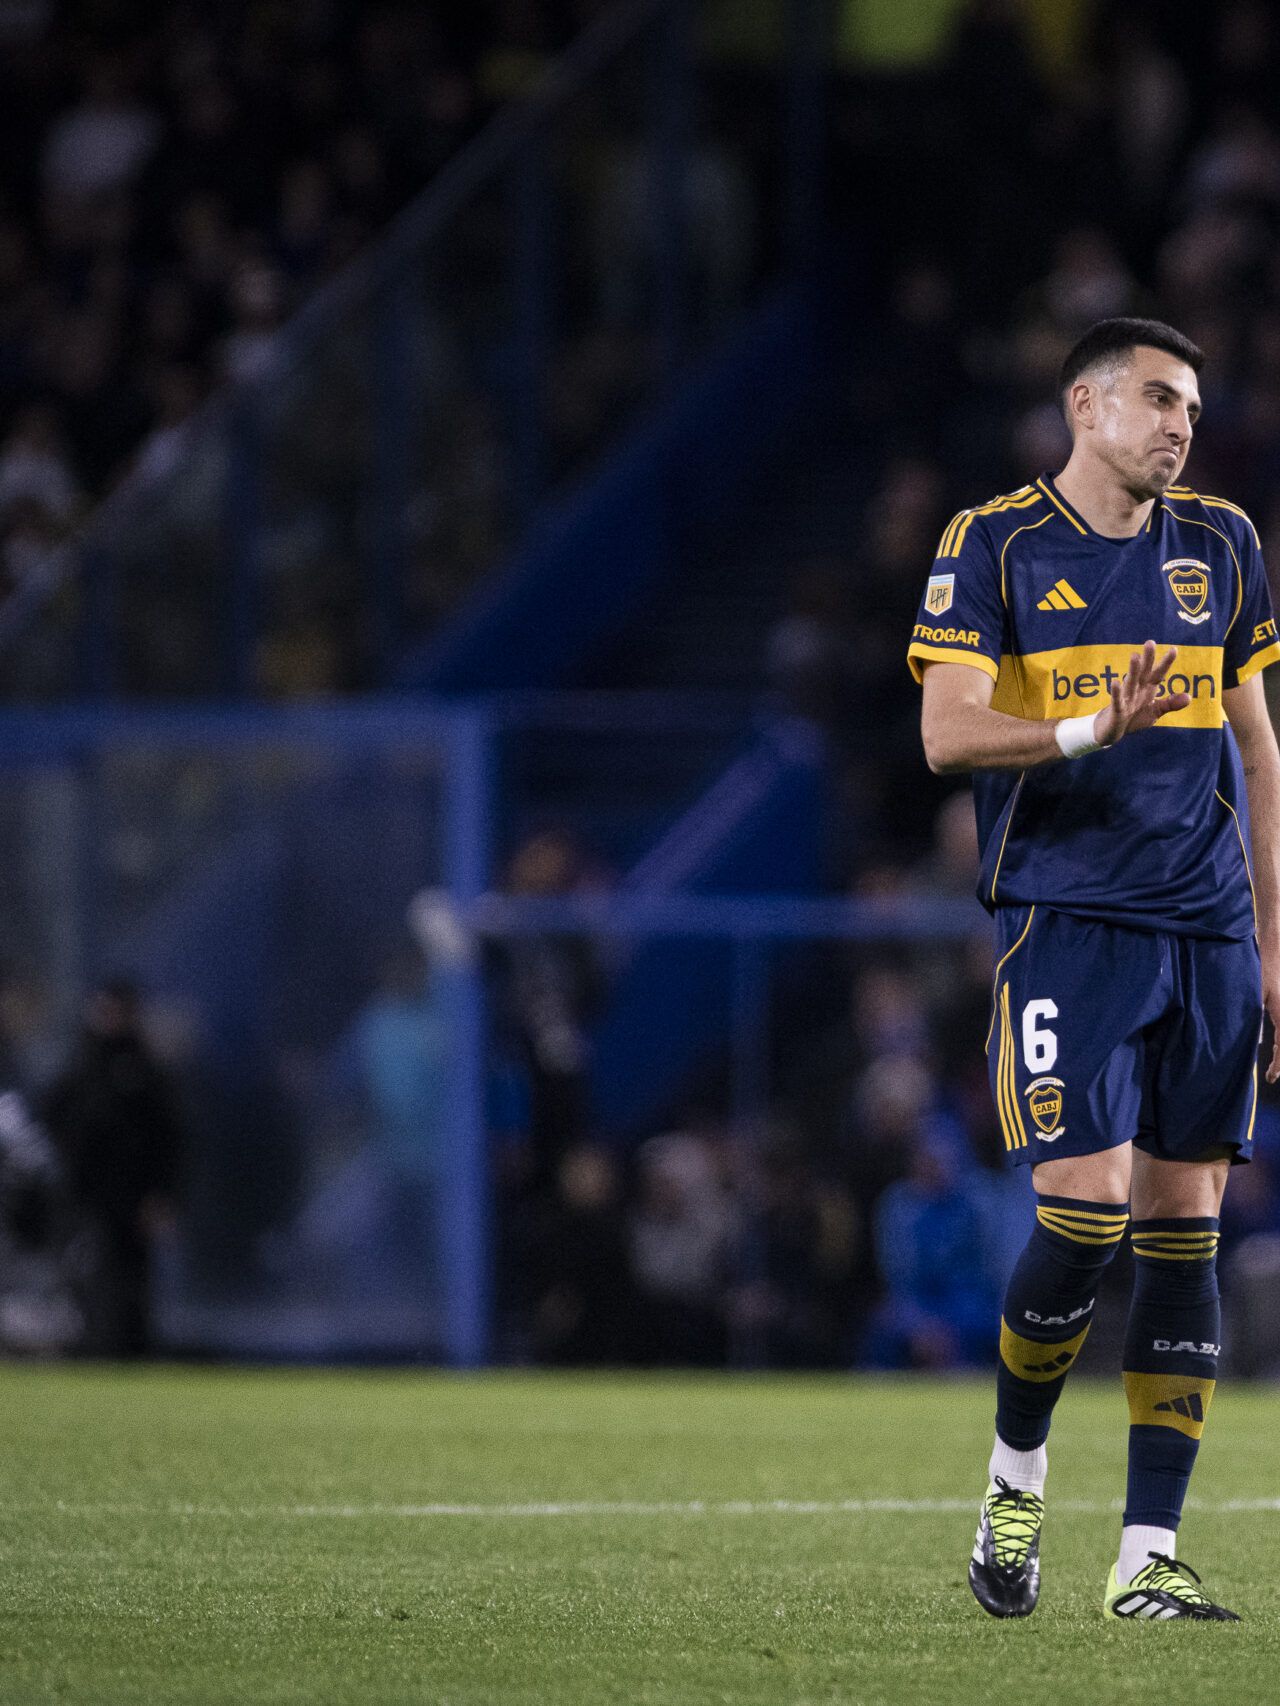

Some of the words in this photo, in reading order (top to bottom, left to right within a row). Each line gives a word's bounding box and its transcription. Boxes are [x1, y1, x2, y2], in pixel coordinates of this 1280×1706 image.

[1176, 585, 1202, 593] CABJ
[913, 624, 980, 647] TROGAR
[1251, 618, 1277, 645] ET
[1052, 665, 1215, 701] beton
[1022, 998, 1058, 1074] 6
[1036, 1102, 1057, 1114] CABJ
